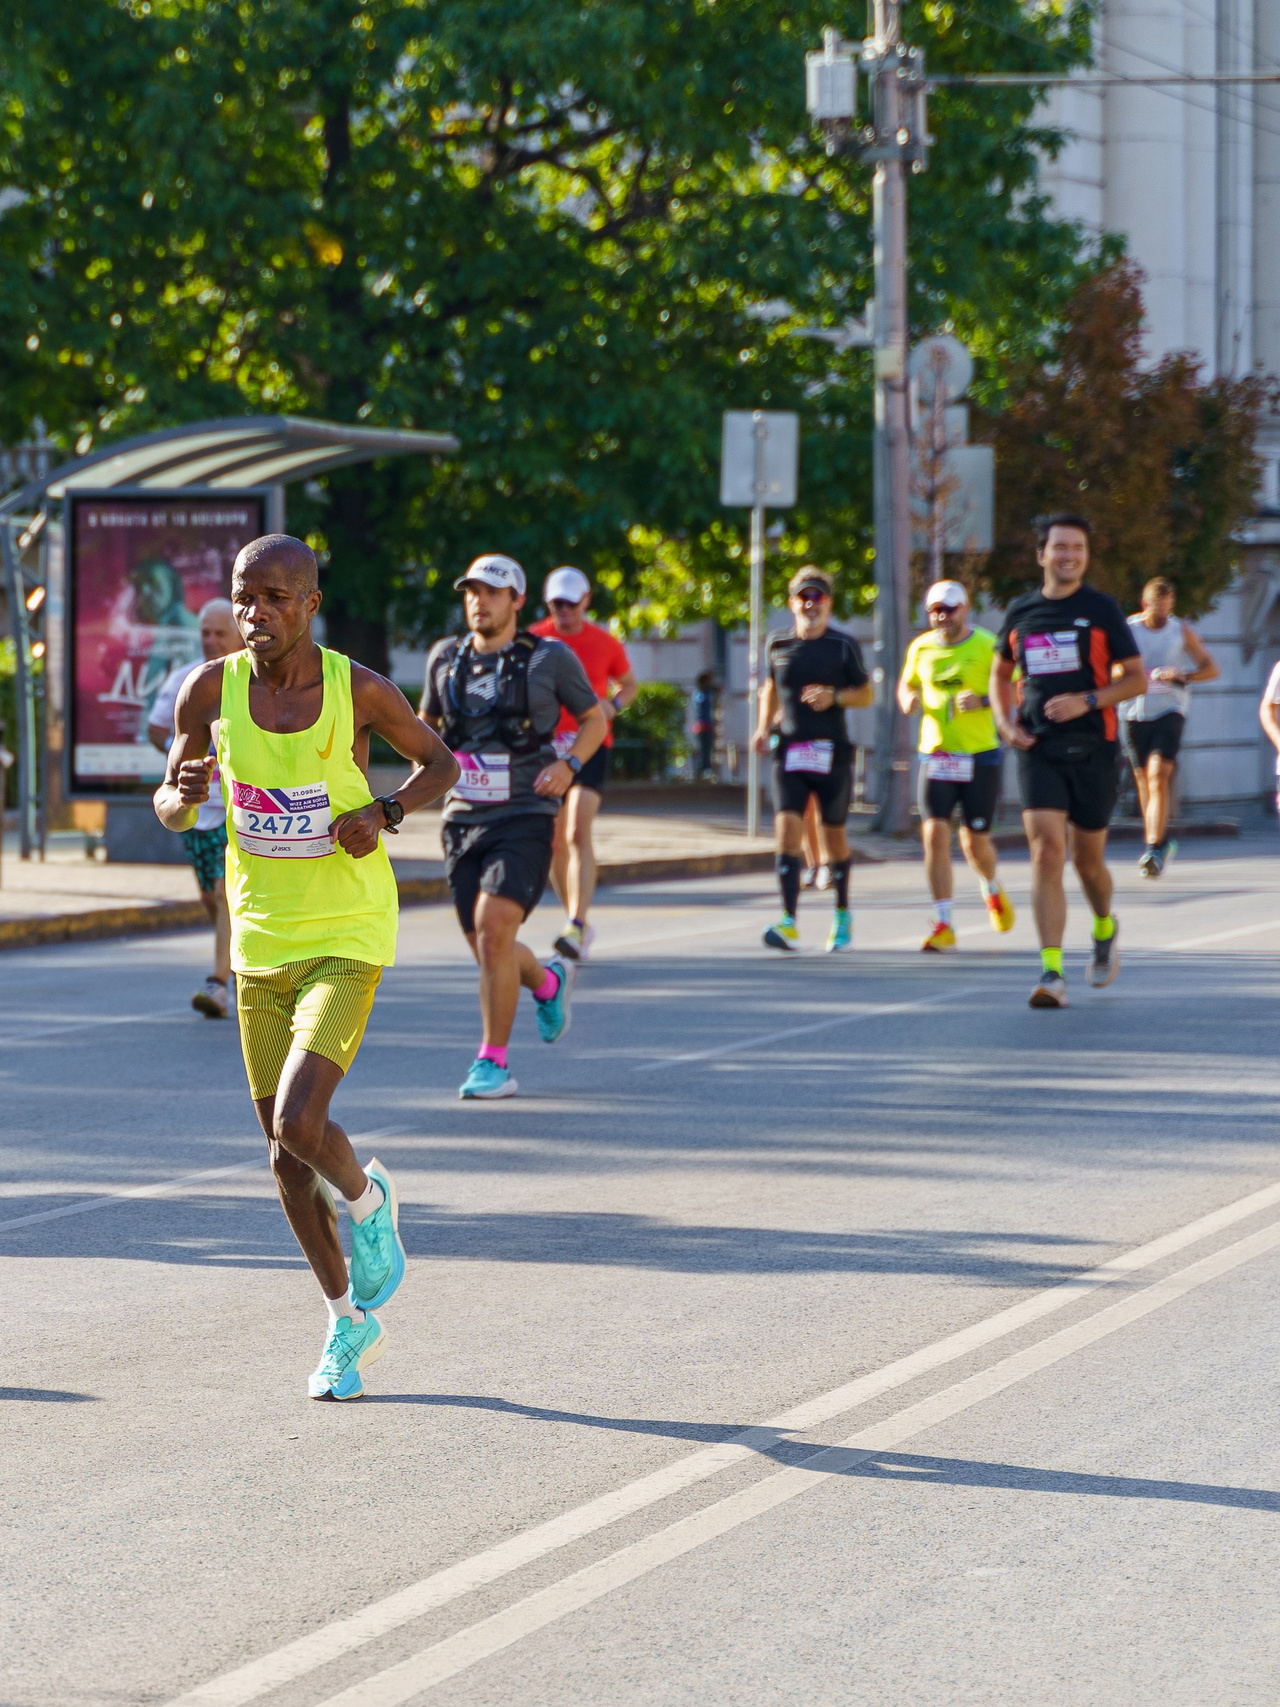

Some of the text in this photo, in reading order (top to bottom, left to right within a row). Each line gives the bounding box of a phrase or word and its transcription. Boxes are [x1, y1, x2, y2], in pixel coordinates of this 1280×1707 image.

[464, 772, 490, 786] 156
[292, 788, 313, 797] 21.098
[289, 803, 316, 811] MARATHON
[247, 813, 313, 835] 2472
